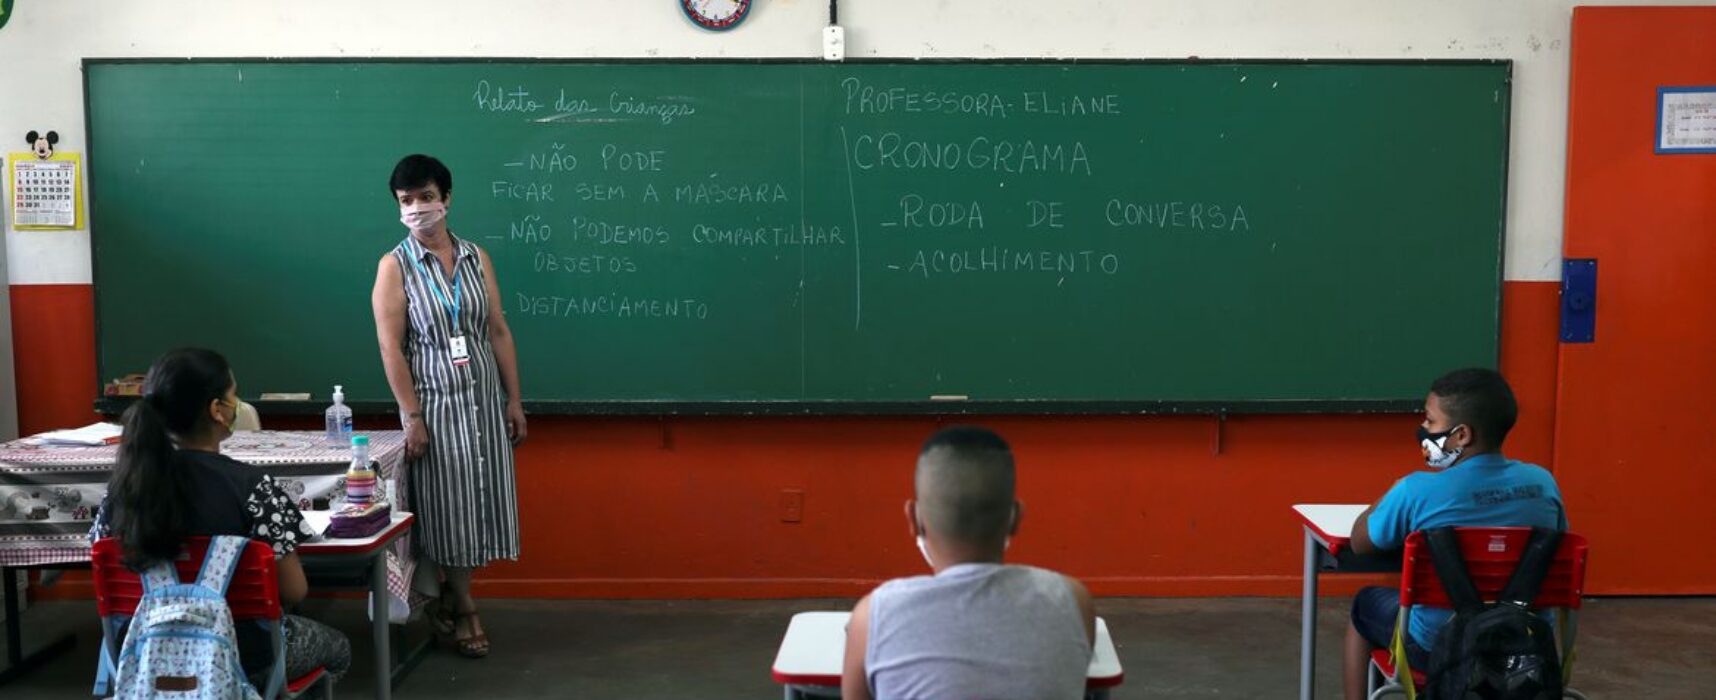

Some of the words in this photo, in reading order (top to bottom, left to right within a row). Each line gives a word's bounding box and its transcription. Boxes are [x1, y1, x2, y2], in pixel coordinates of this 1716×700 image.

[472, 80, 544, 113] Relato
[553, 88, 598, 113] das
[609, 83, 696, 124] Crianças
[602, 143, 665, 172] PODE
[853, 131, 1092, 175] CRONOGRAMA
[576, 182, 625, 202] SEM
[643, 182, 660, 203] A
[1025, 200, 1065, 228] DE
[1104, 198, 1250, 231] CONVERSA
[572, 215, 671, 245] PODEMOS
[533, 253, 638, 274] OBJETOS
